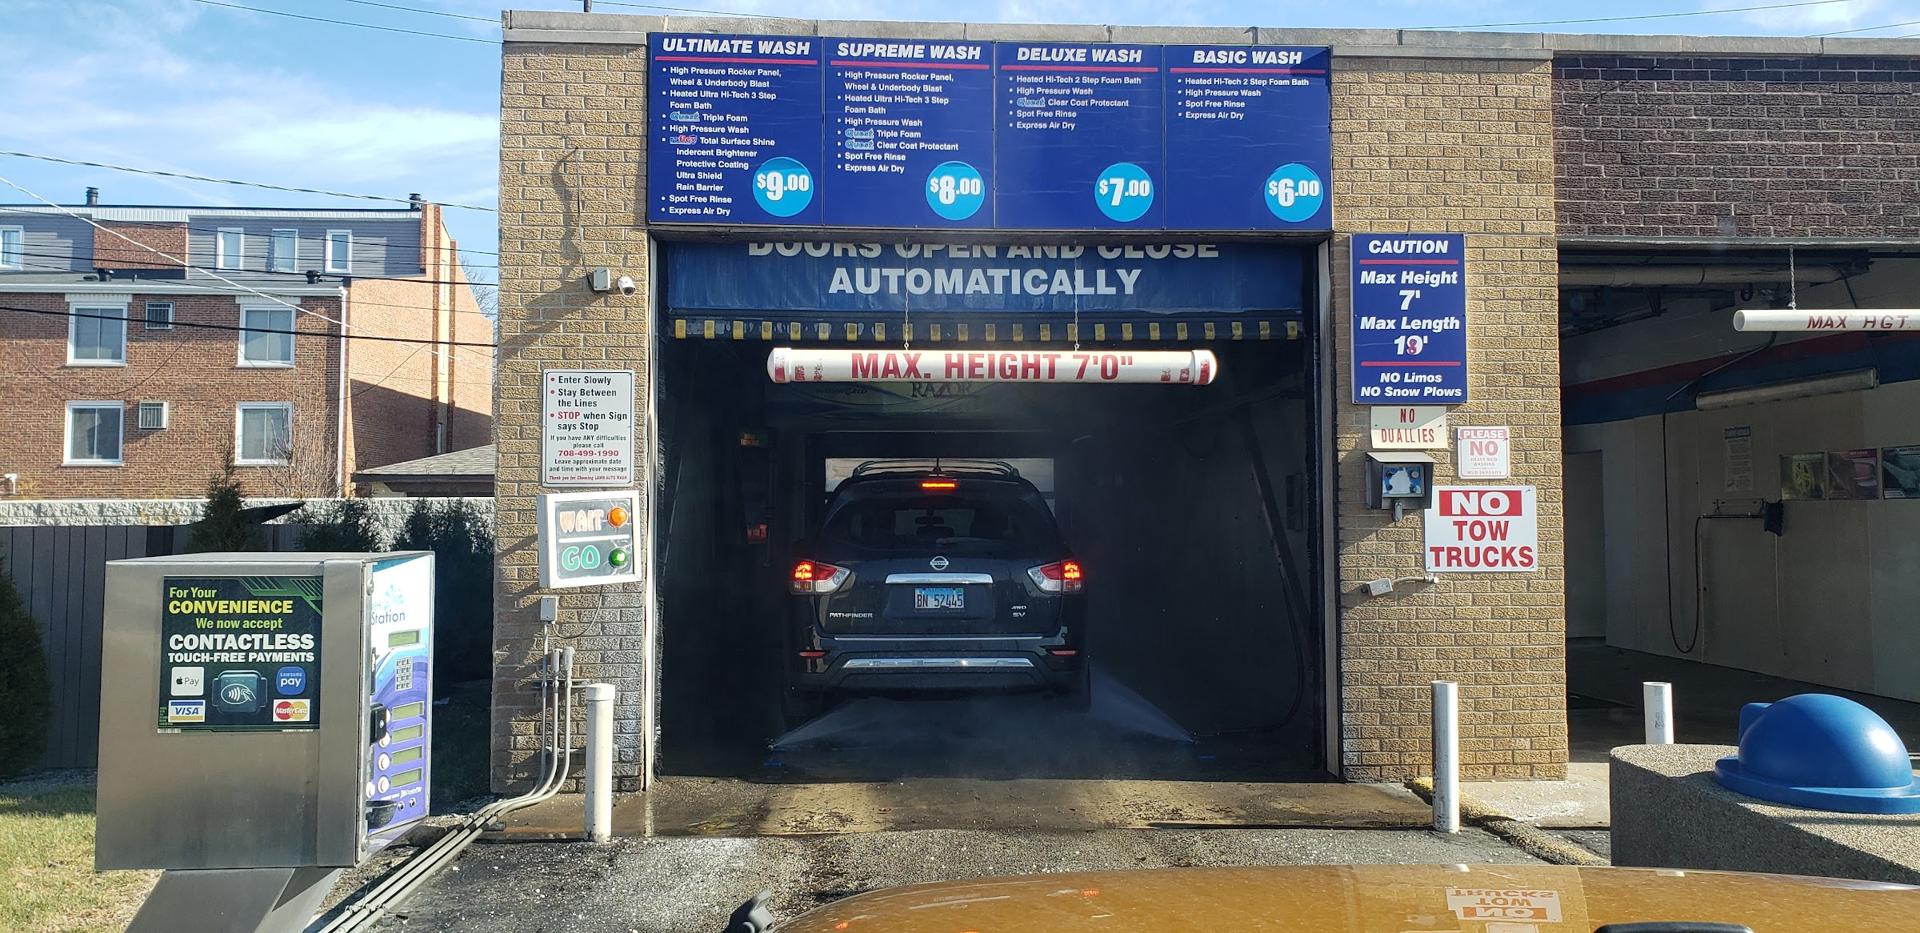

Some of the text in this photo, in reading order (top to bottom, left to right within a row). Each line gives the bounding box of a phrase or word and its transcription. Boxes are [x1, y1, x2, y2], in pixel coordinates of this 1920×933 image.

[663, 38, 810, 55] ULTIMATE WASH
[837, 43, 981, 60] SUPREME WASH
[1017, 47, 1142, 63] DELUXE WASH
[1193, 50, 1302, 64] BASIC WASH
[670, 66, 782, 77] High Pressure Rocker Panel,
[705, 79, 748, 88] Underbody
[1016, 75, 1044, 83] Heated
[1082, 76, 1100, 85] Step
[1249, 78, 1268, 87] Step
[670, 89, 698, 97] Heated
[721, 91, 750, 99] Hi-Tech
[758, 91, 777, 101] Step
[1016, 87, 1035, 96] High
[702, 113, 724, 123] Triple
[670, 125, 688, 134] High
[690, 125, 726, 133] Pressure
[876, 129, 898, 139] Triple
[720, 137, 751, 145] Surface
[716, 149, 757, 158] Brightener
[676, 160, 749, 170] Protective Coating
[697, 172, 722, 180] Shield
[696, 183, 724, 191] Barrier
[757, 171, 809, 201] $9.00
[930, 175, 981, 205] $8.00
[1099, 178, 1151, 206] $7.00
[1269, 178, 1320, 207] $6.00
[669, 194, 688, 203] Spot
[669, 206, 701, 215] Express
[716, 207, 731, 216] Dry
[1369, 240, 1448, 254] CAUTION
[828, 268, 1141, 295] AUTOMATICALLY
[1360, 270, 1458, 287] Max Height
[1399, 290, 1420, 310] 7'
[1360, 316, 1460, 333] Max Length
[1807, 316, 1847, 329] MAX
[850, 353, 931, 380] MAX.
[945, 353, 1062, 380] HEIGHT
[558, 375, 611, 386] Enter Slowly
[1380, 372, 1442, 383] NO Limos
[558, 388, 616, 398] Stay Between
[1361, 386, 1462, 397] NO Snow Plows
[558, 399, 597, 407] the Lines
[558, 411, 627, 421] STOP when Sign
[1400, 408, 1415, 423] NO
[557, 422, 599, 432] says Stop
[1463, 430, 1504, 439] PLEASE
[1470, 440, 1498, 456] NO
[1452, 492, 1510, 515] NO
[1453, 520, 1509, 541] TOW
[562, 545, 600, 571] GO
[1429, 546, 1534, 568] TRUCKS
[170, 587, 217, 598] For Your
[917, 593, 964, 608] BN 52445
[169, 600, 293, 614] CONVENIENCE
[196, 618, 283, 631] We now accept
[169, 634, 314, 650] CONTACTLESS
[168, 652, 314, 663] TOUCH-FREE PAYMENTS
[184, 677, 200, 687] Pay
[280, 678, 302, 687] pay
[175, 707, 199, 715] VISA
